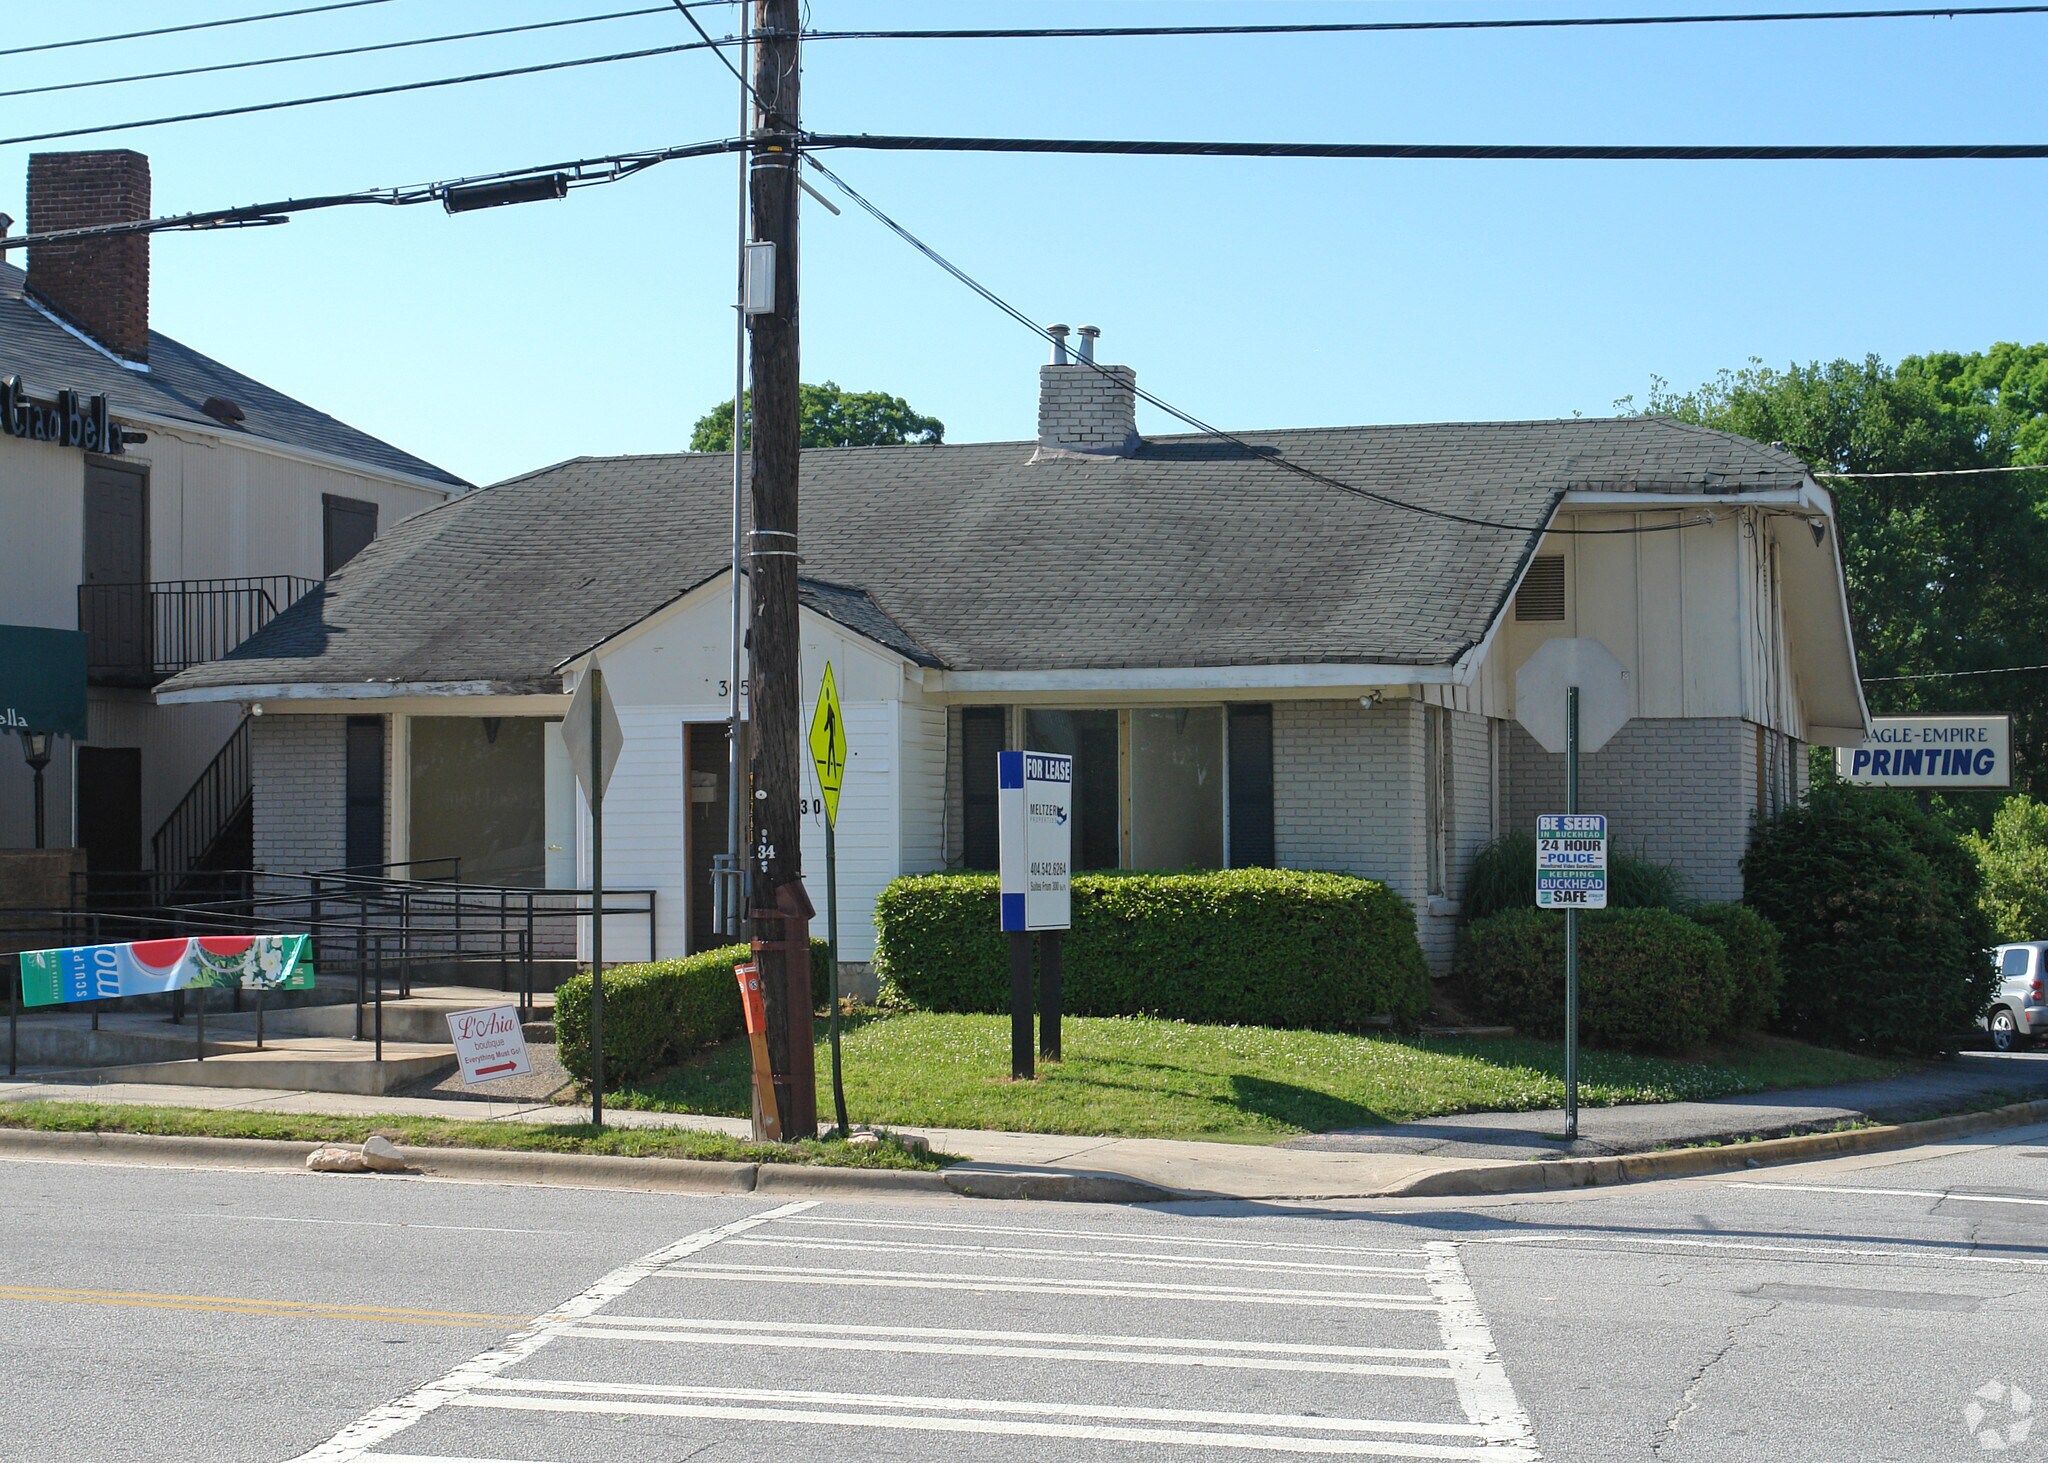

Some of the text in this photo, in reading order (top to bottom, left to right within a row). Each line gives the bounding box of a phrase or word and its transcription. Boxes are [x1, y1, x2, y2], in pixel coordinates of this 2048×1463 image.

[2, 374, 125, 454] Ciao Bella
[718, 680, 749, 697] 35
[1864, 727, 1988, 743] AGLE-EMPIRE
[1027, 758, 1070, 781] FOR LEASE
[1852, 749, 1995, 776] PRINTING
[1030, 803, 1057, 816] MELTZER
[1540, 817, 1600, 831] BE SEEN
[757, 845, 776, 859] 34
[1541, 839, 1602, 851] 24 HOUR
[1548, 853, 1595, 863] POLICE
[1030, 862, 1067, 876] 404.542.6264
[1549, 870, 1595, 878] KEEPING
[1541, 878, 1604, 889] BUCKHEAD
[1553, 890, 1587, 903] SAFE
[457, 1012, 513, 1040] L'Asia
[474, 1039, 505, 1051] boutique
[464, 1053, 496, 1064] Everything
[495, 1049, 510, 1058] Must
